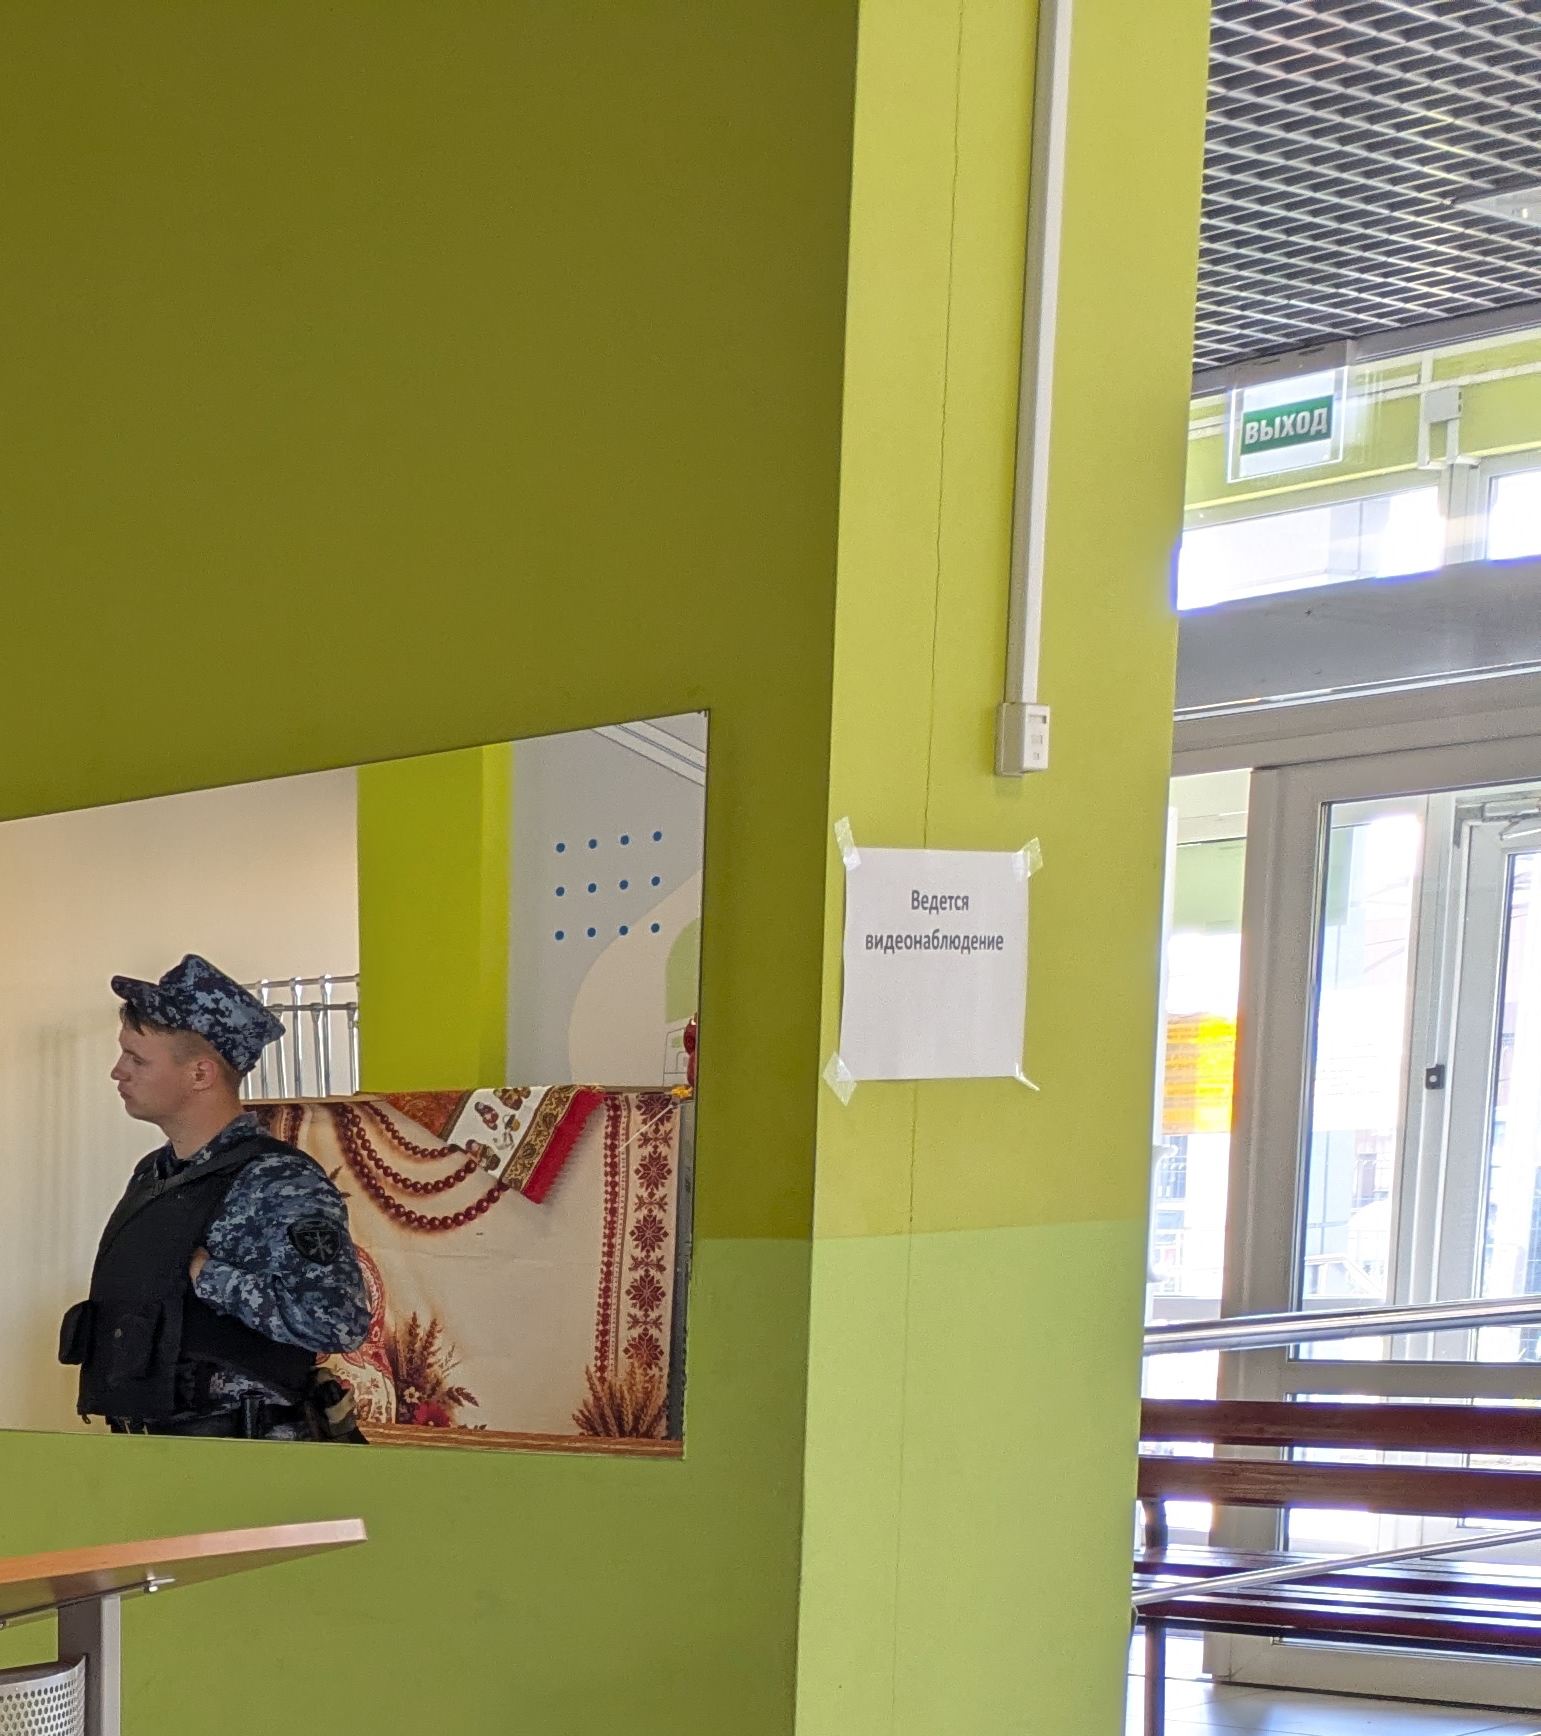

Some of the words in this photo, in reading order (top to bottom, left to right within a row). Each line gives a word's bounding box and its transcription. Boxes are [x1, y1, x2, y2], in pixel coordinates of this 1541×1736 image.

[1244, 407, 1328, 446] ВЫХОД
[911, 889, 969, 914] Ведется
[865, 929, 1004, 954] видеонаблюдение
